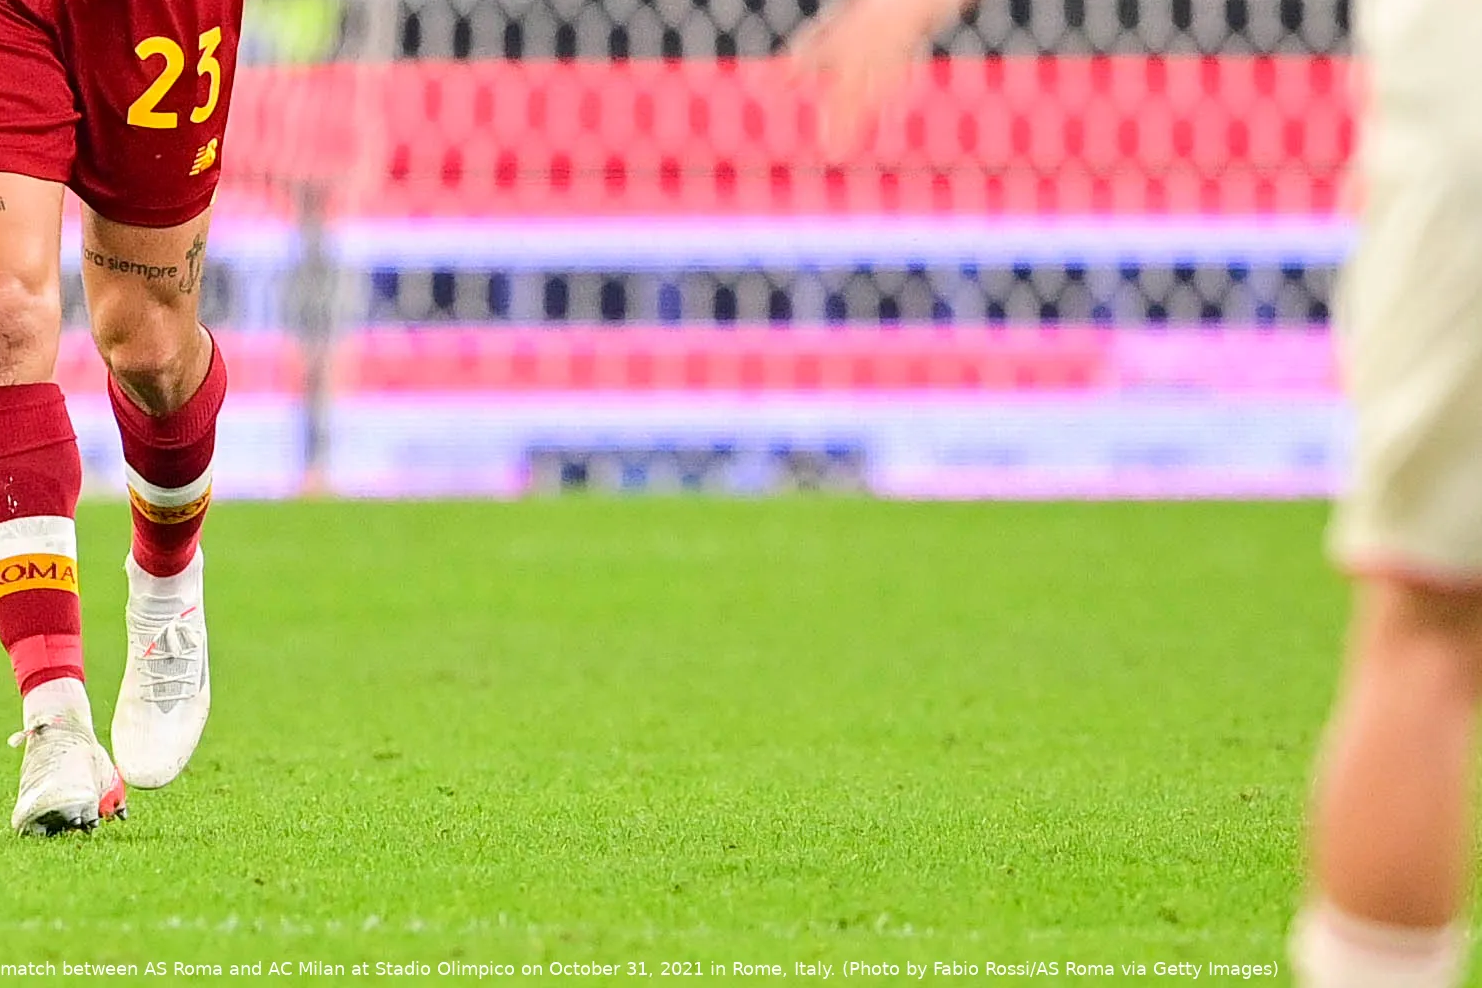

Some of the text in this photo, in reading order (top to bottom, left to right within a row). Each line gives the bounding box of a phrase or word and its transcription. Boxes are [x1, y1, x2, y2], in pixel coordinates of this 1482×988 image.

[126, 26, 222, 130] 23
[84, 248, 178, 281] ara siempre
